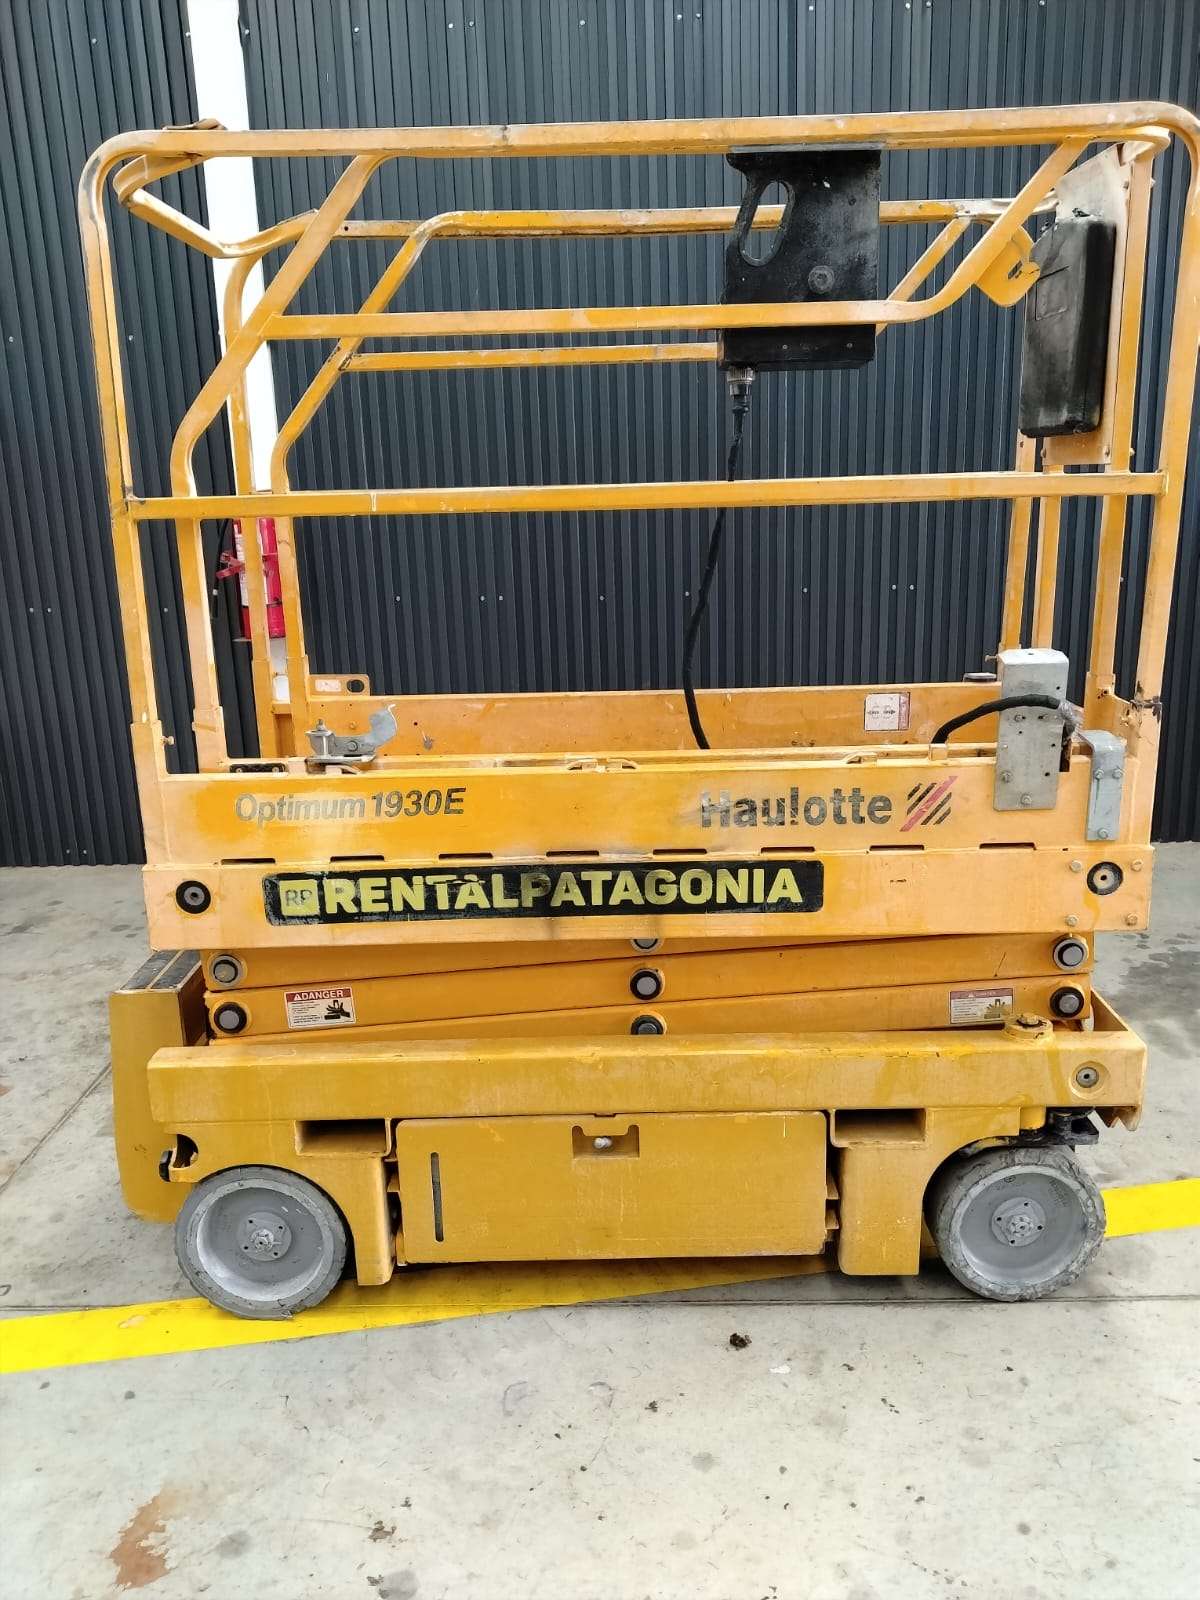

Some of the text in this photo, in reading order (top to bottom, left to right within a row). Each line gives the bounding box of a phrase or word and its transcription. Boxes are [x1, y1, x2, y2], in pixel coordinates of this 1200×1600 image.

[235, 787, 467, 826] Optimum 1930E
[700, 786, 893, 828] Haulotte
[301, 990, 344, 1001] DANGER
